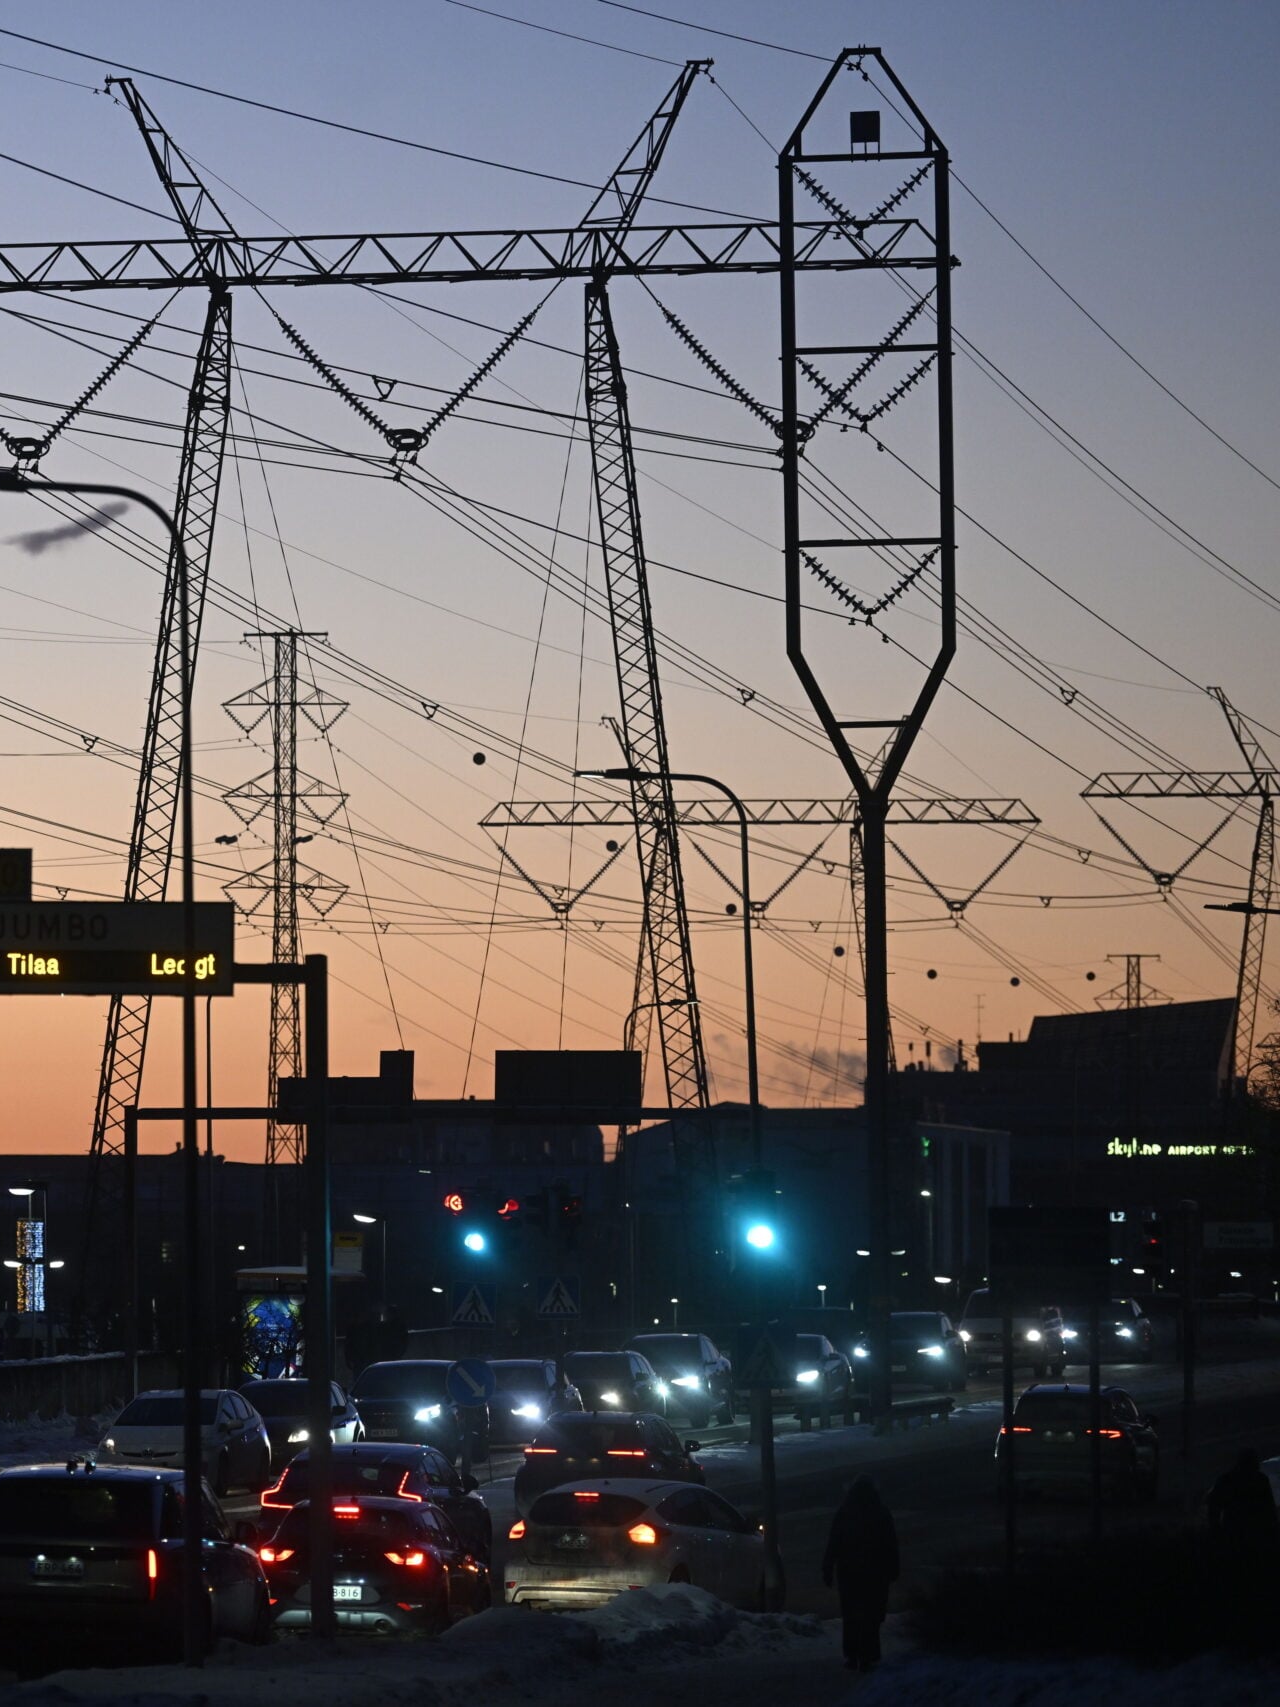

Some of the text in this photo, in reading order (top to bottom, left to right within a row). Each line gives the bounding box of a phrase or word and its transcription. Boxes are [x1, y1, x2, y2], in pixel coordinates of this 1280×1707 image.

[6, 952, 216, 980] Tilaa Legt
[1106, 1136, 1162, 1159] skylne
[1168, 1144, 1217, 1156] AIRPORT
